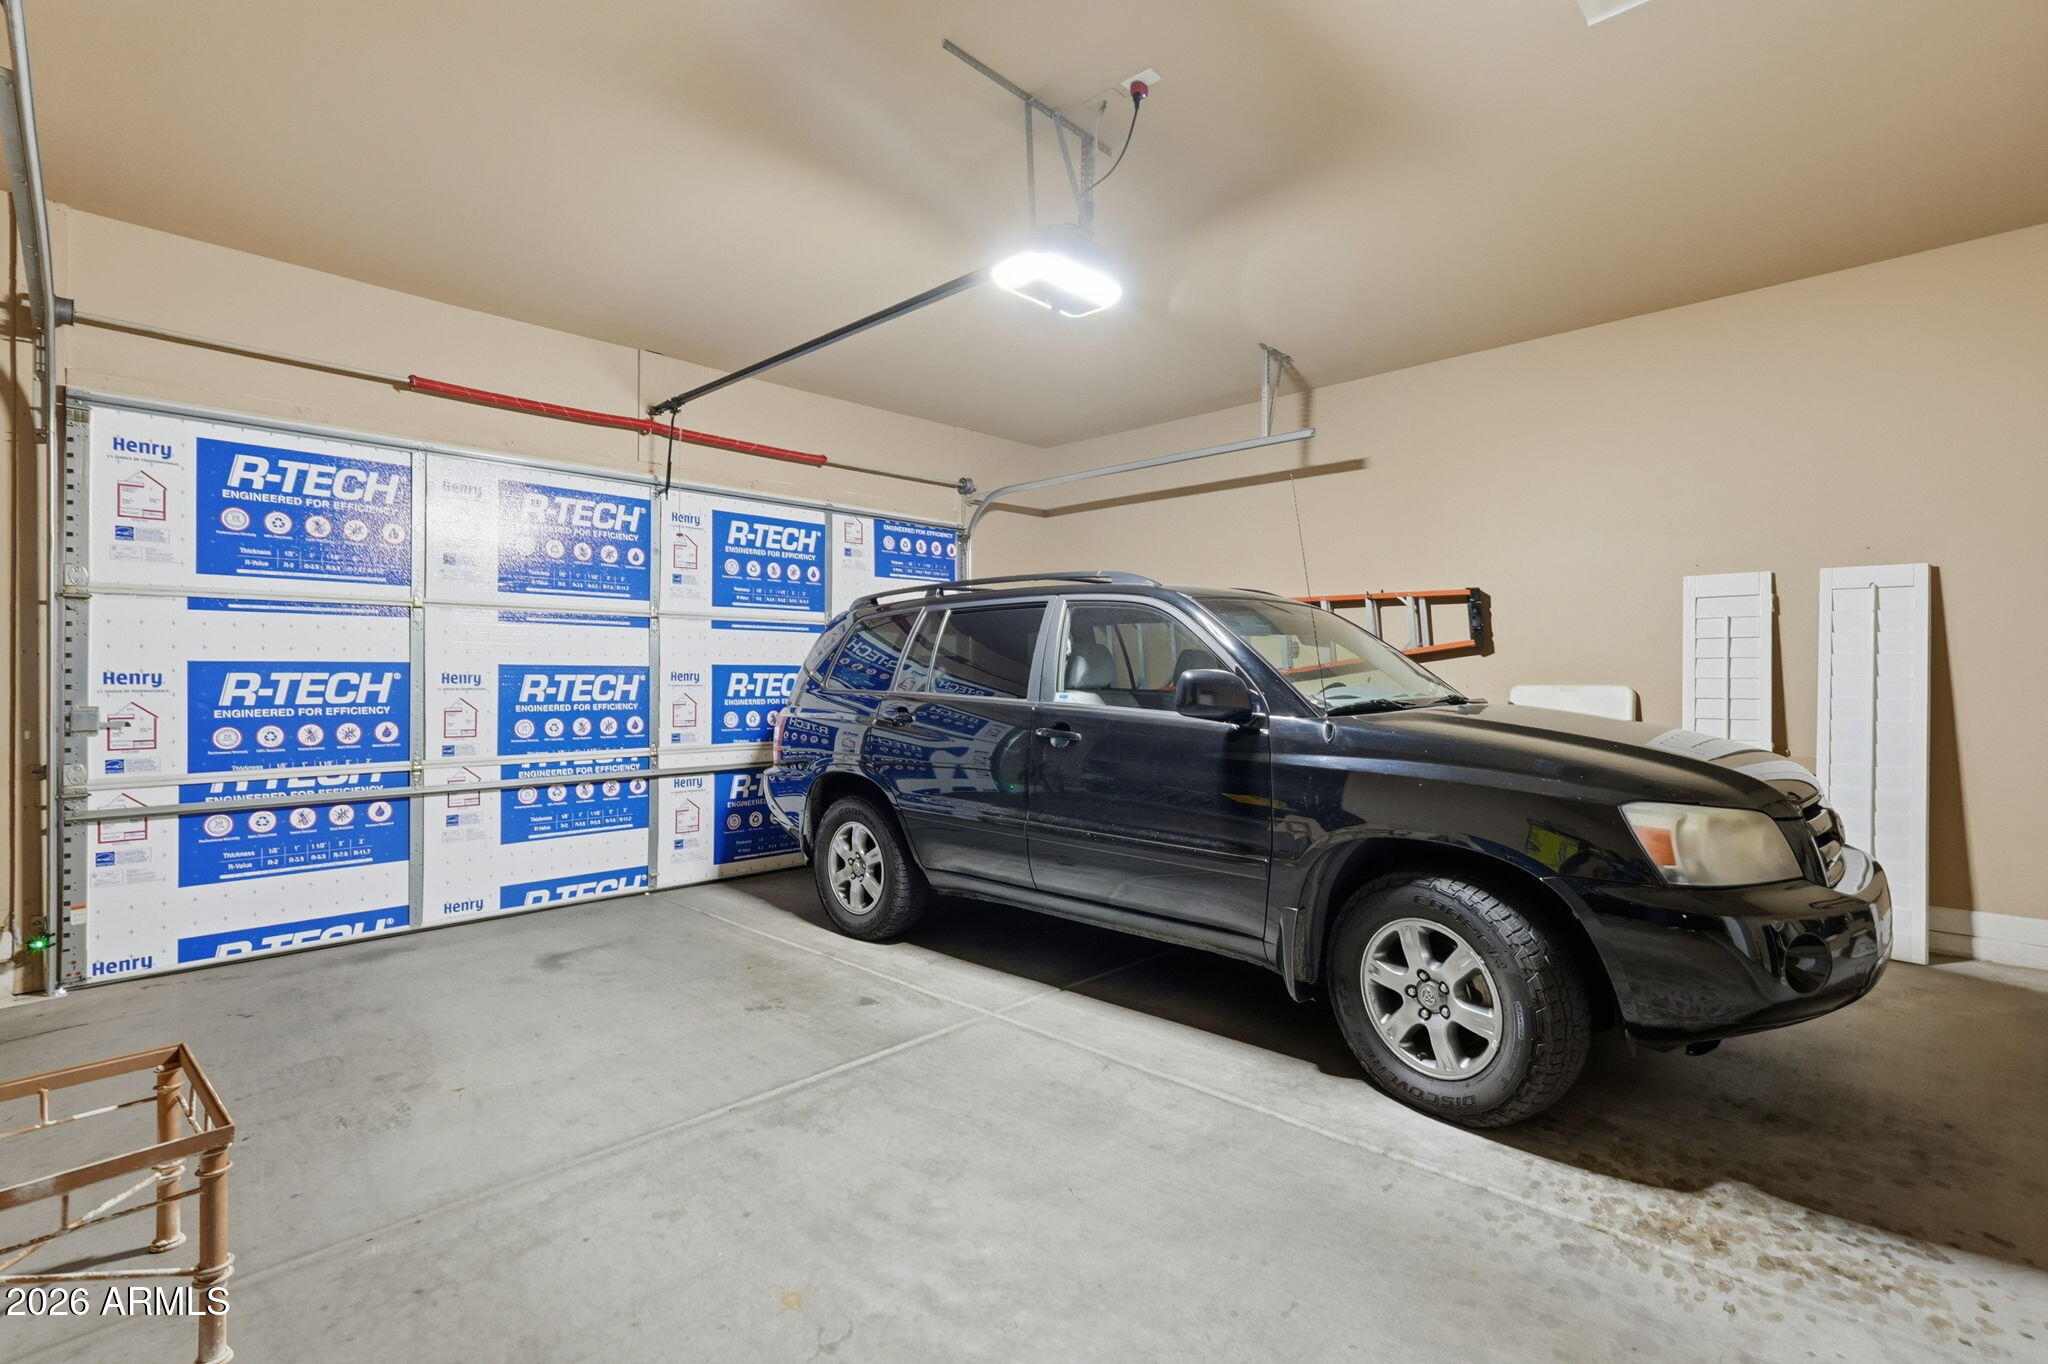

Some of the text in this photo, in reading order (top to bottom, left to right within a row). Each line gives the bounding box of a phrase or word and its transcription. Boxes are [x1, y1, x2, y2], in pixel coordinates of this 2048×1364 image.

[113, 437, 172, 459] Henry
[222, 489, 302, 506] ENGINEERED
[306, 499, 330, 509] FOR
[671, 512, 701, 527] Henry
[103, 671, 162, 688] Henry
[441, 672, 482, 686] Henry
[670, 671, 700, 684] Henry
[213, 705, 391, 719] ENGINEERED FOR EFFICIENCY
[515, 702, 638, 713] ENGINEERED FOR EFFICIENCY
[518, 768, 574, 779] ENGINEERED
[576, 766, 593, 775] FOR
[594, 763, 640, 774] EFFICIENCY
[673, 776, 703, 788] Henry
[443, 899, 484, 914] Henry
[92, 955, 153, 977] Henry
